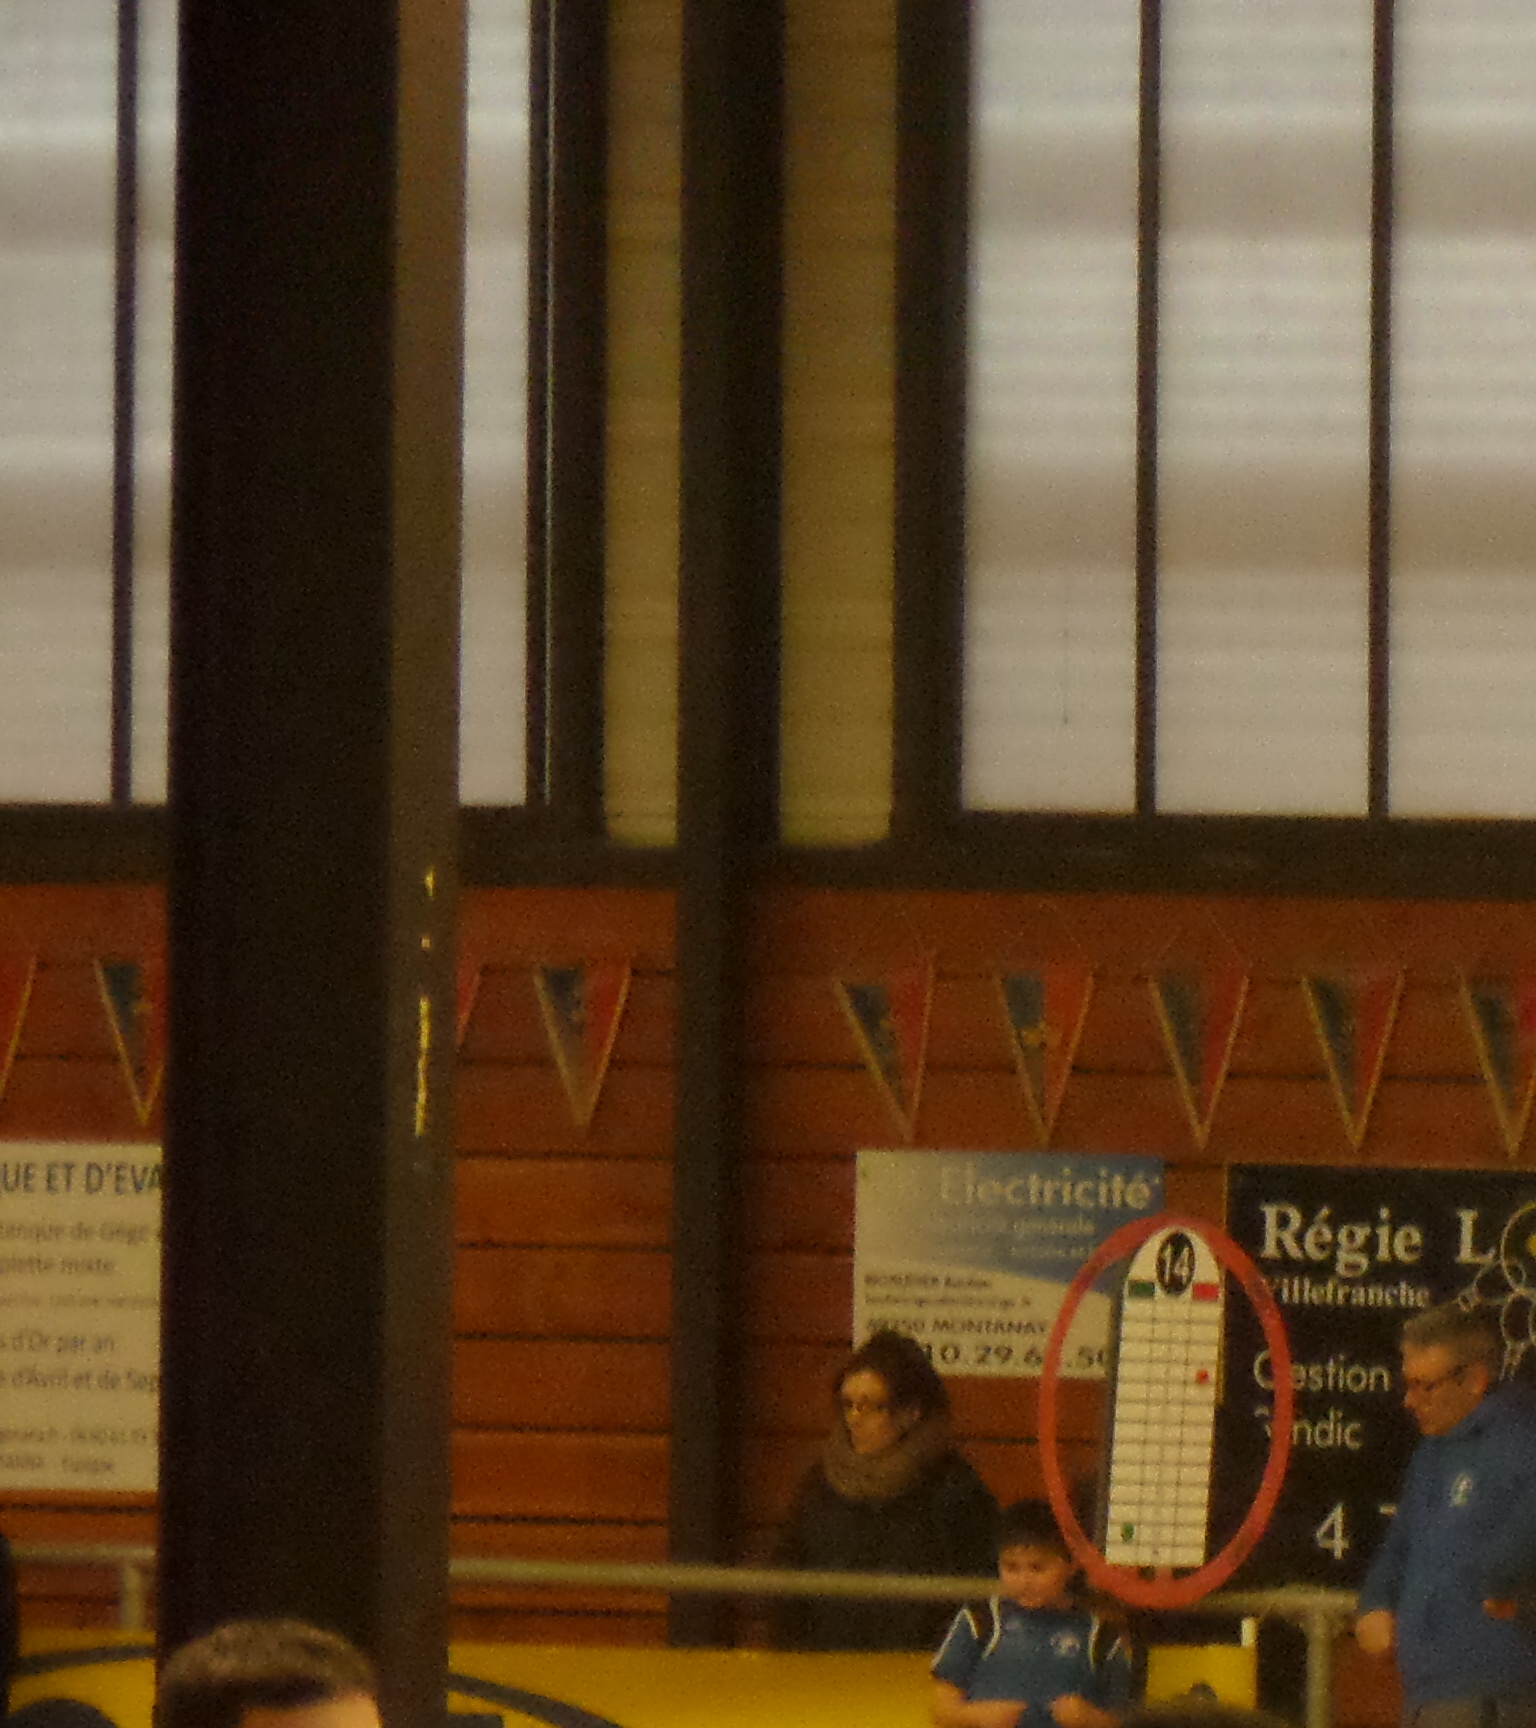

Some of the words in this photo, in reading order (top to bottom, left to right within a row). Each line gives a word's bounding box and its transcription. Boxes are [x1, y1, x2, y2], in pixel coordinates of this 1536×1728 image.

[46, 1161, 75, 1194] ET
[1260, 1203, 1423, 1278] Régie
[1163, 1242, 1190, 1287] 14
